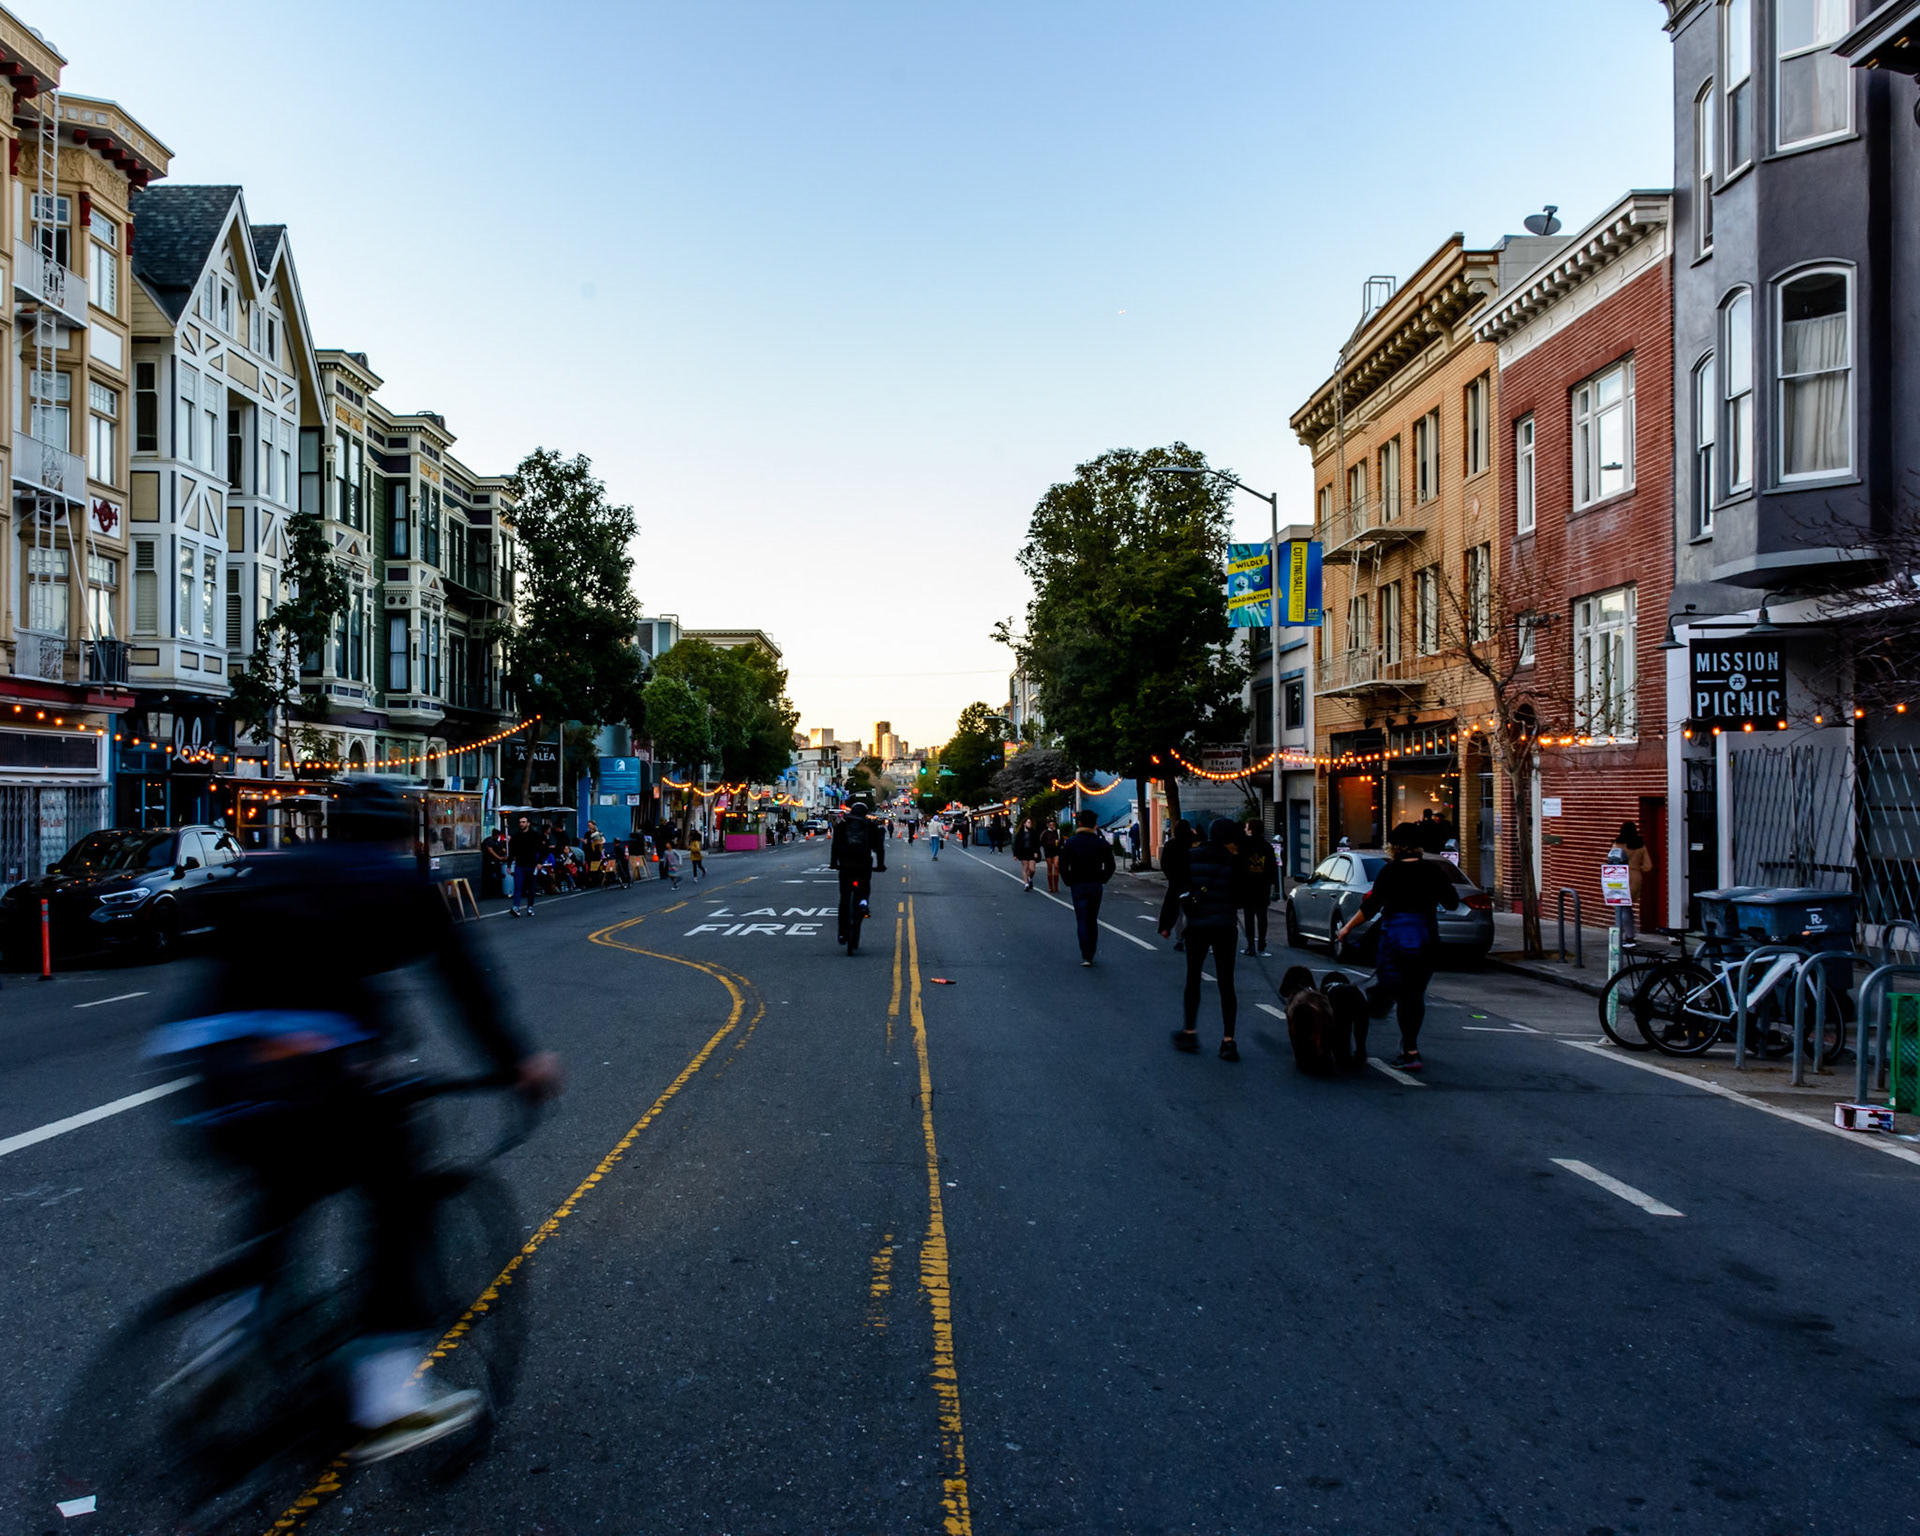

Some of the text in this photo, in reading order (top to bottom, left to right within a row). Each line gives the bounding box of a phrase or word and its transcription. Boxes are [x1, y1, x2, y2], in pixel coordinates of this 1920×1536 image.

[1235, 558, 1264, 569] WILDLY
[1229, 592, 1270, 604] IMAGINATIVE
[1696, 651, 1779, 673] MISSION
[1696, 690, 1781, 717] PICNIC
[517, 752, 556, 761] AALEA
[707, 907, 840, 917] LANE
[683, 922, 823, 937] FIRE
